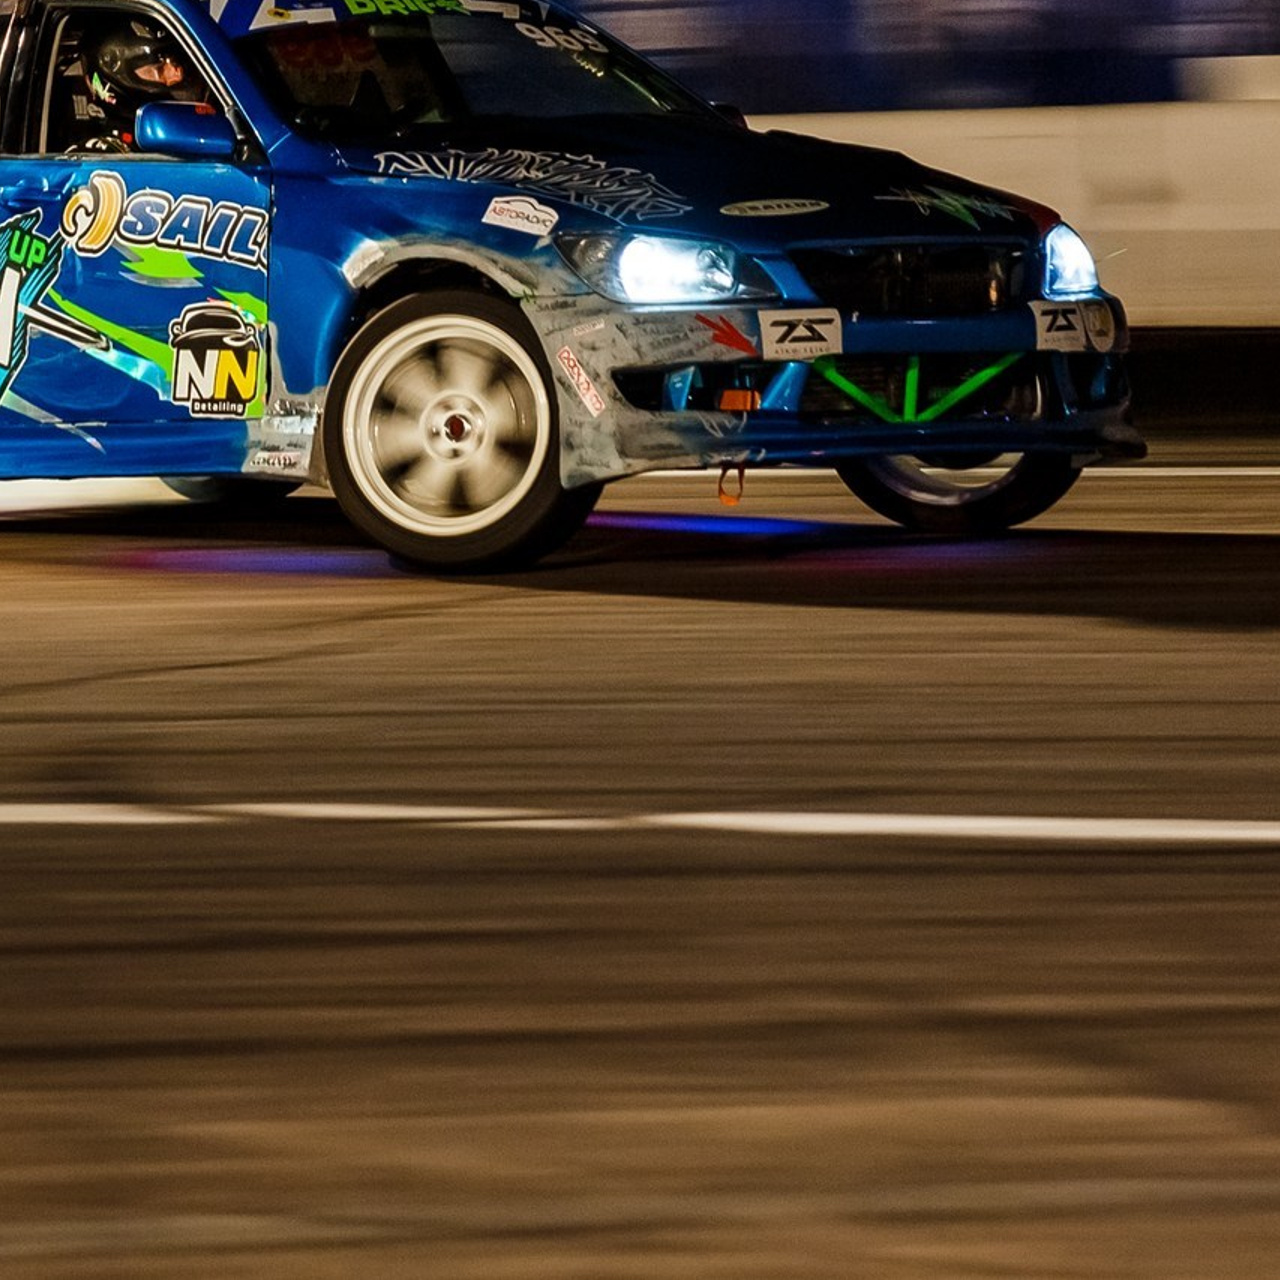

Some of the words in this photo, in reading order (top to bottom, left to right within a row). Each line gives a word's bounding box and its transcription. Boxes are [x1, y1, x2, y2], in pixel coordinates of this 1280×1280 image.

[515, 22, 609, 53] 969
[118, 194, 268, 266] SAIL
[7, 230, 47, 269] UP
[193, 402, 244, 413] Detailing
